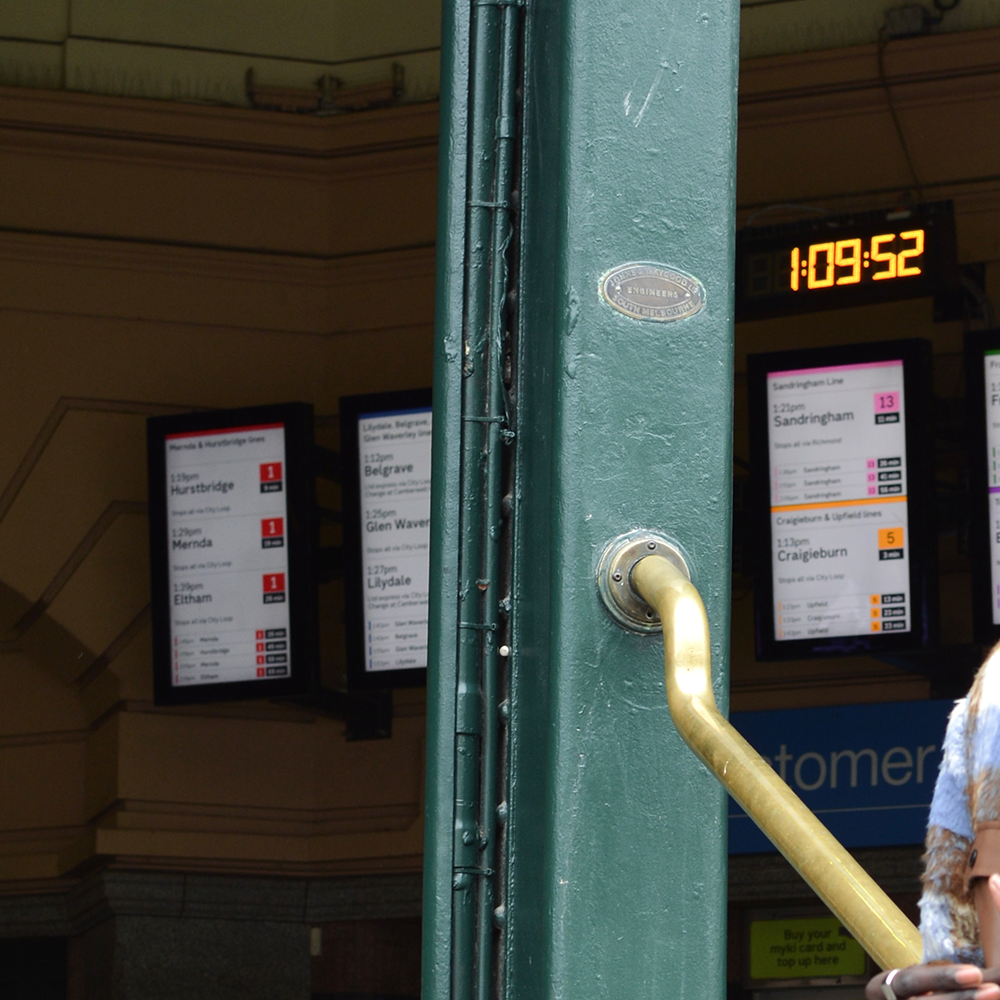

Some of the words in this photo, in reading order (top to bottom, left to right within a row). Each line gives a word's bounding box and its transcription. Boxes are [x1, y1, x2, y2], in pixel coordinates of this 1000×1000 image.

[790, 230, 924, 291] 1:09:52
[627, 287, 678, 299] ENGINEERS
[612, 295, 640, 313] SOUTH
[642, 301, 694, 317] MELBOURNE
[773, 380, 825, 391] Sandringham
[826, 378, 843, 386] Line
[880, 396, 894, 408] 13
[774, 411, 854, 427] Sandringham
[364, 453, 394, 463] 1:12pm
[267, 465, 274, 478] 1
[364, 464, 413, 477] Belgrave
[171, 481, 234, 495] Hurstbridge
[776, 516, 822, 525] Craigieburn
[832, 511, 861, 522] Upfield
[269, 521, 276, 534] 1
[366, 521, 392, 533] Glen
[172, 538, 212, 550] Mernda
[778, 538, 810, 548] 1:13pm
[887, 532, 895, 544] 5
[778, 547, 848, 563] Craigieburn
[270, 576, 277, 589] 1
[367, 576, 411, 590] Lilydale
[174, 593, 212, 606] Eltham
[784, 929, 805, 942] Buy
[807, 929, 831, 941] your
[770, 943, 797, 956] myki
[801, 942, 824, 952] card
[827, 941, 846, 951] and
[777, 956, 796, 968] top
[798, 957, 812, 968] up
[814, 955, 838, 965] here
